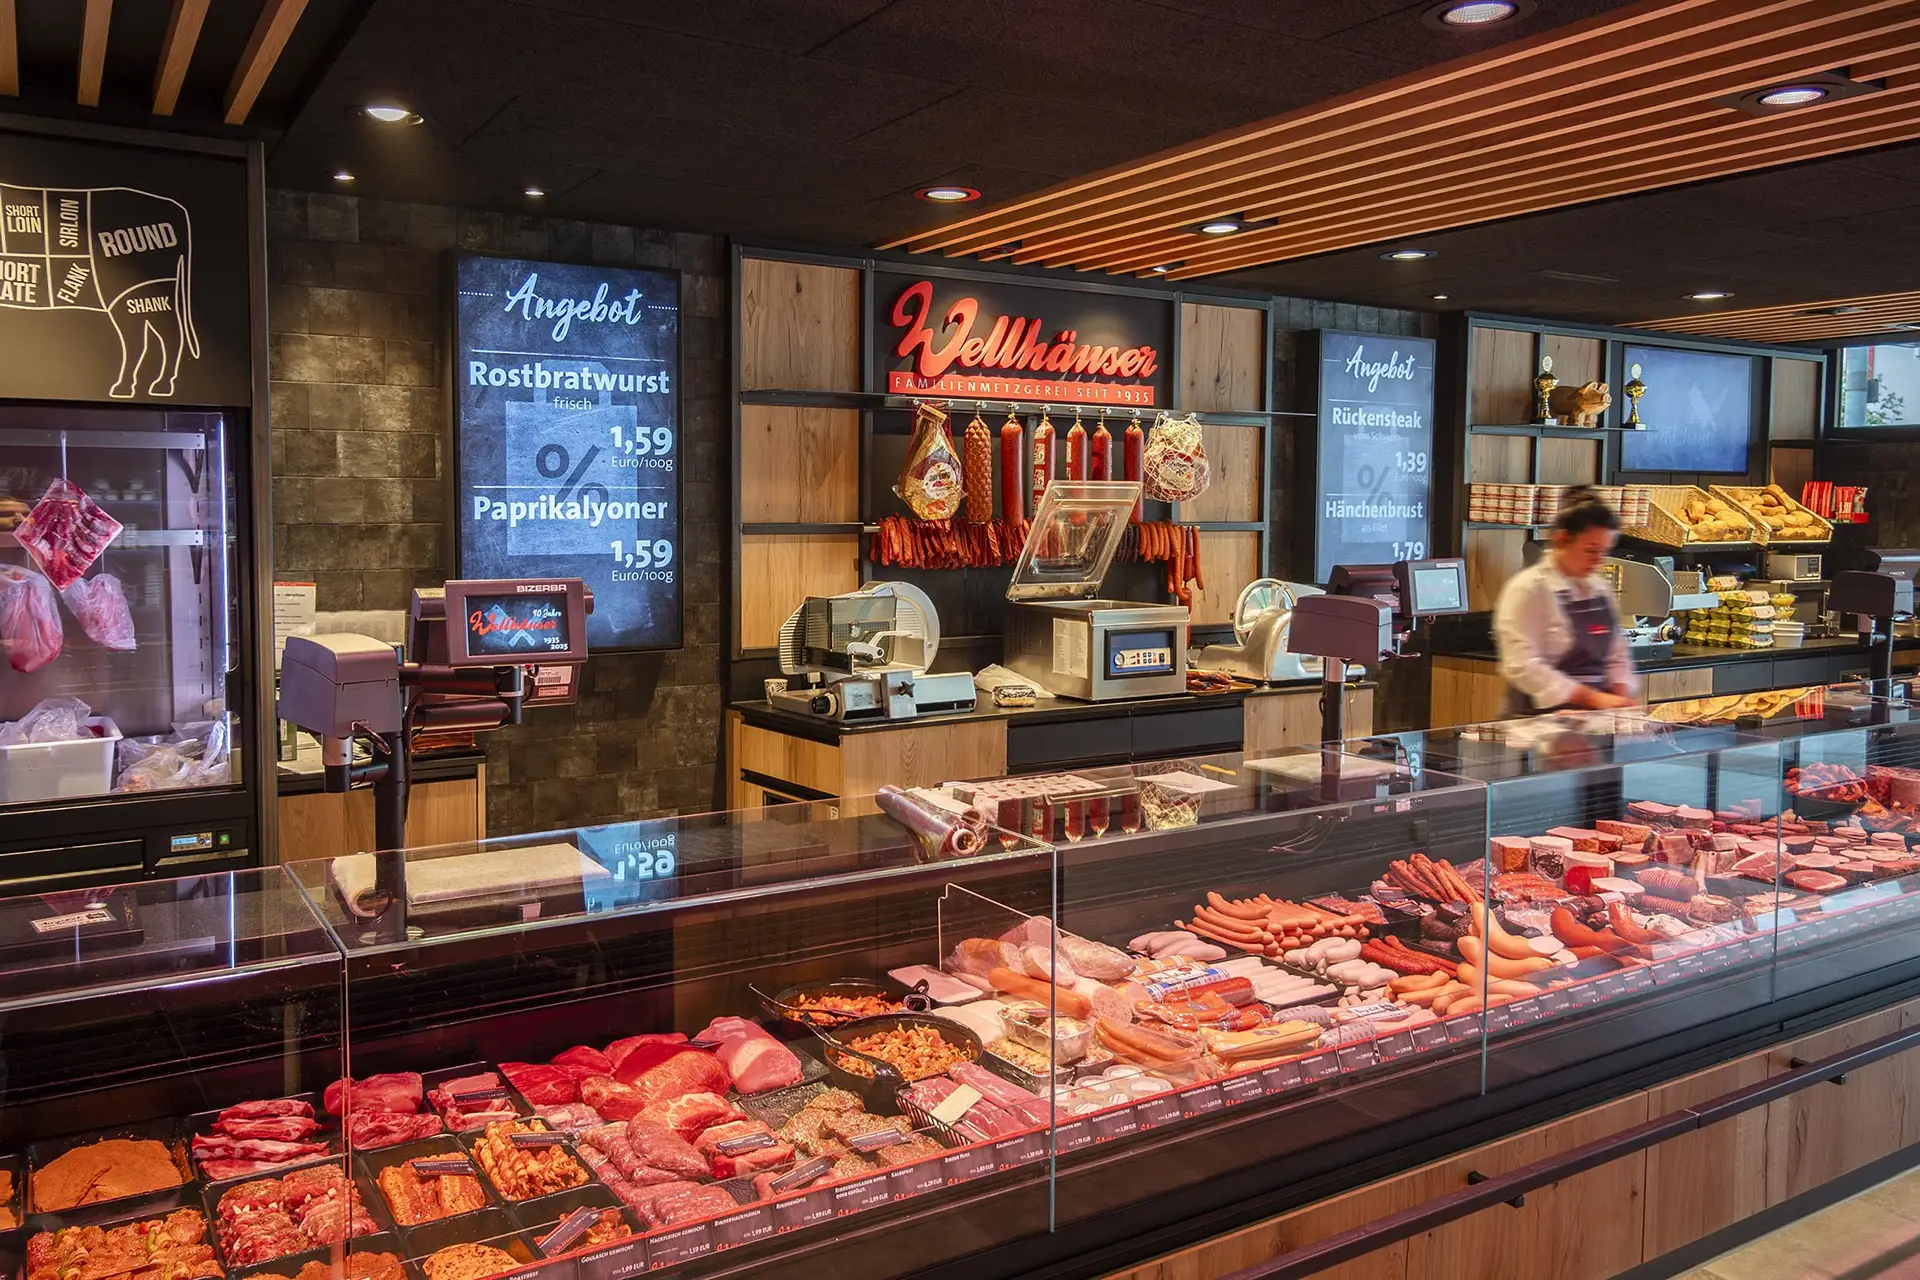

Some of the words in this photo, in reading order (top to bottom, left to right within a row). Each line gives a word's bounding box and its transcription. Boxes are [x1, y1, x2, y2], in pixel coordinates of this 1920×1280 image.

[6, 205, 40, 217] SHORT
[7, 216, 42, 234] LOIN
[60, 199, 79, 248] SIRLOIN
[98, 222, 178, 258] ROUND
[0, 281, 37, 303] ATE
[57, 263, 90, 304] FLANK
[126, 296, 172, 314] SHANK
[505, 273, 642, 343] Angebot
[892, 281, 1159, 378] Wellhäuser
[469, 361, 670, 394] Rostbratwurst
[1345, 344, 1416, 393] Angebot
[895, 377, 1069, 397] FAMILIENMETZGEREI
[1077, 386, 1109, 399] SEIT
[1116, 390, 1150, 403] 1935
[553, 396, 593, 411] frisch
[1332, 406, 1422, 429] Rückensteak
[610, 426, 674, 457] 1,59
[611, 455, 674, 472] Euro/100g
[1395, 451, 1427, 473] 1,39
[474, 496, 668, 528] Paprikalyoner
[1325, 500, 1424, 519] Hänchenbrust
[1361, 523, 1372, 533] als
[610, 539, 674, 570] 1,59
[1392, 541, 1425, 561] 1,79
[611, 568, 674, 584] Euro/100g
[543, 636, 560, 644] 1935
[550, 643, 569, 651] 2025
[699, 1242, 711, 1252] EUR
[633, 1261, 645, 1270] EUR
